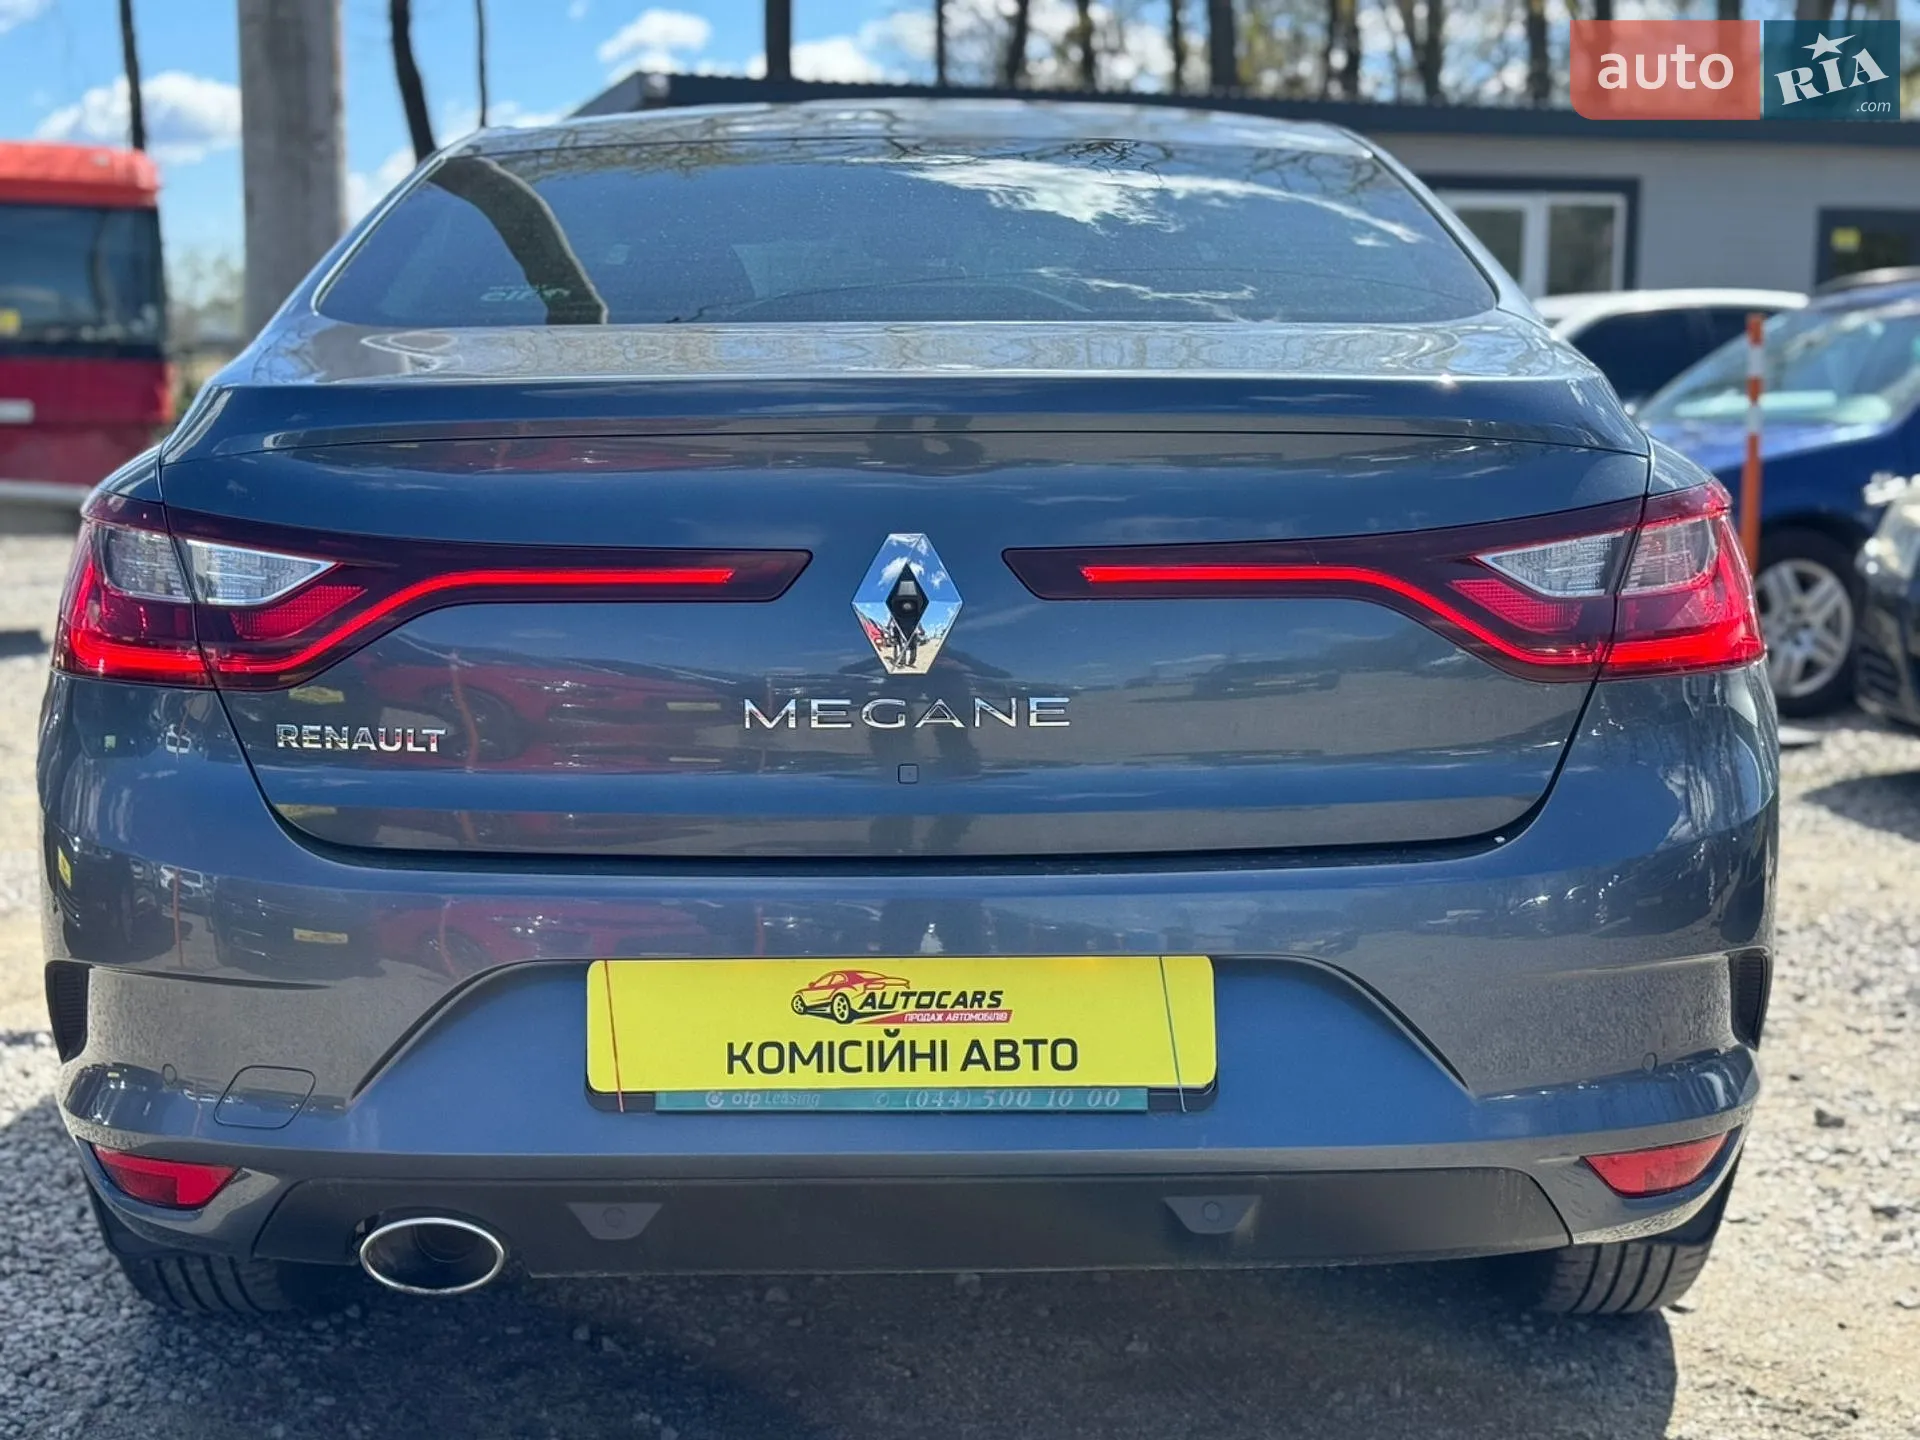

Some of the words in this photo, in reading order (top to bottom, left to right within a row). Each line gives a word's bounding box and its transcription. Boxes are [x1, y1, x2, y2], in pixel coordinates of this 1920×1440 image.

[744, 697, 1072, 729] MEGANE
[276, 724, 446, 752] RENAULT
[858, 990, 1003, 1010] AUTOCARS
[904, 1012, 943, 1022] ПРОДАЖ
[945, 1011, 1008, 1022] АВТОМОБІЛІВ
[726, 1028, 948, 1074] КОМІСІЙНІ
[960, 1038, 1079, 1072] АВТО
[982, 1088, 1032, 1108] 500
[1046, 1088, 1074, 1107] 10
[1086, 1087, 1121, 1107] 00
